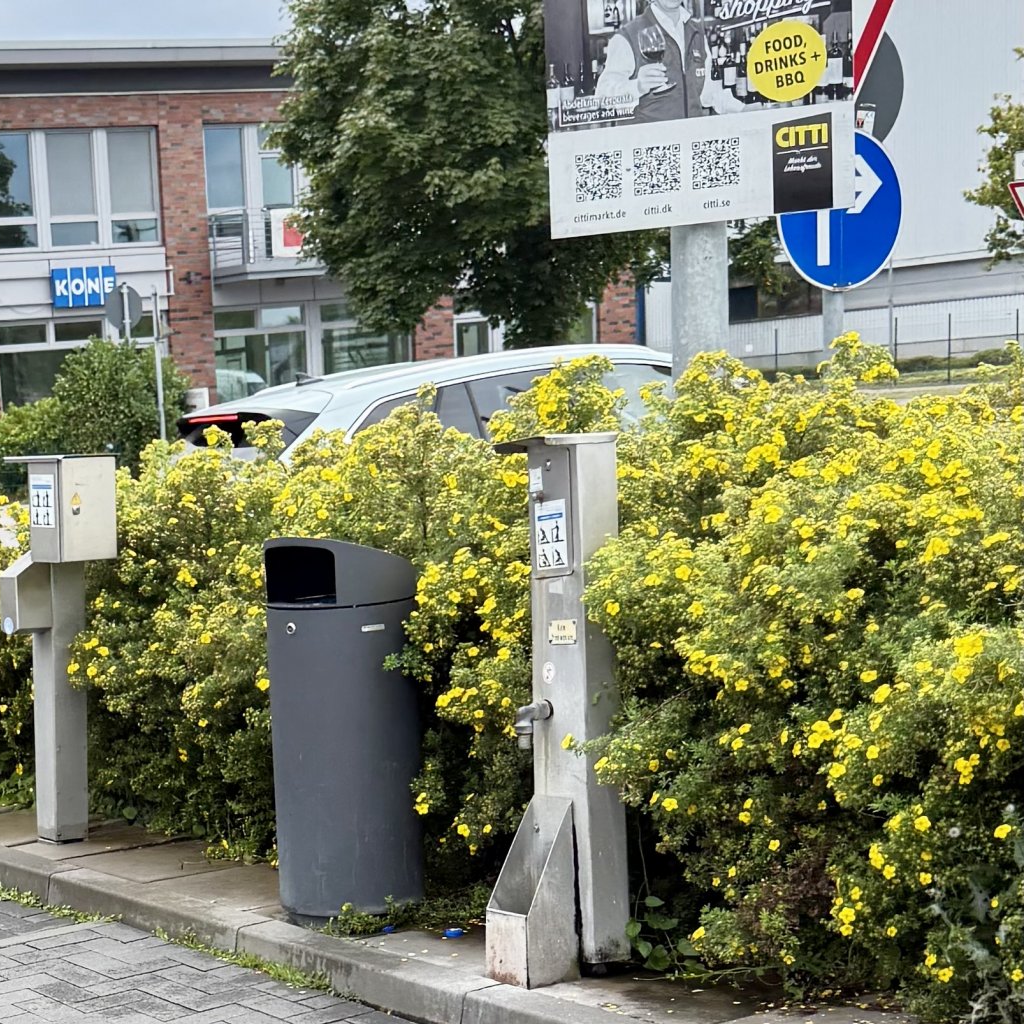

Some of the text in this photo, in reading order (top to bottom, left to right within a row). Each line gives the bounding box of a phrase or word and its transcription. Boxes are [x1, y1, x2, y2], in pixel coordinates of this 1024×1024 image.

[764, 35, 807, 54] FOOD,
[754, 51, 821, 75] DRINKS +
[775, 71, 805, 88] BBQ
[562, 106, 635, 122] beverages and wine
[775, 122, 829, 148] CITTI
[573, 210, 626, 223] cittimarkt.de
[643, 204, 672, 216] citti.dk
[54, 276, 115, 297] KONE
